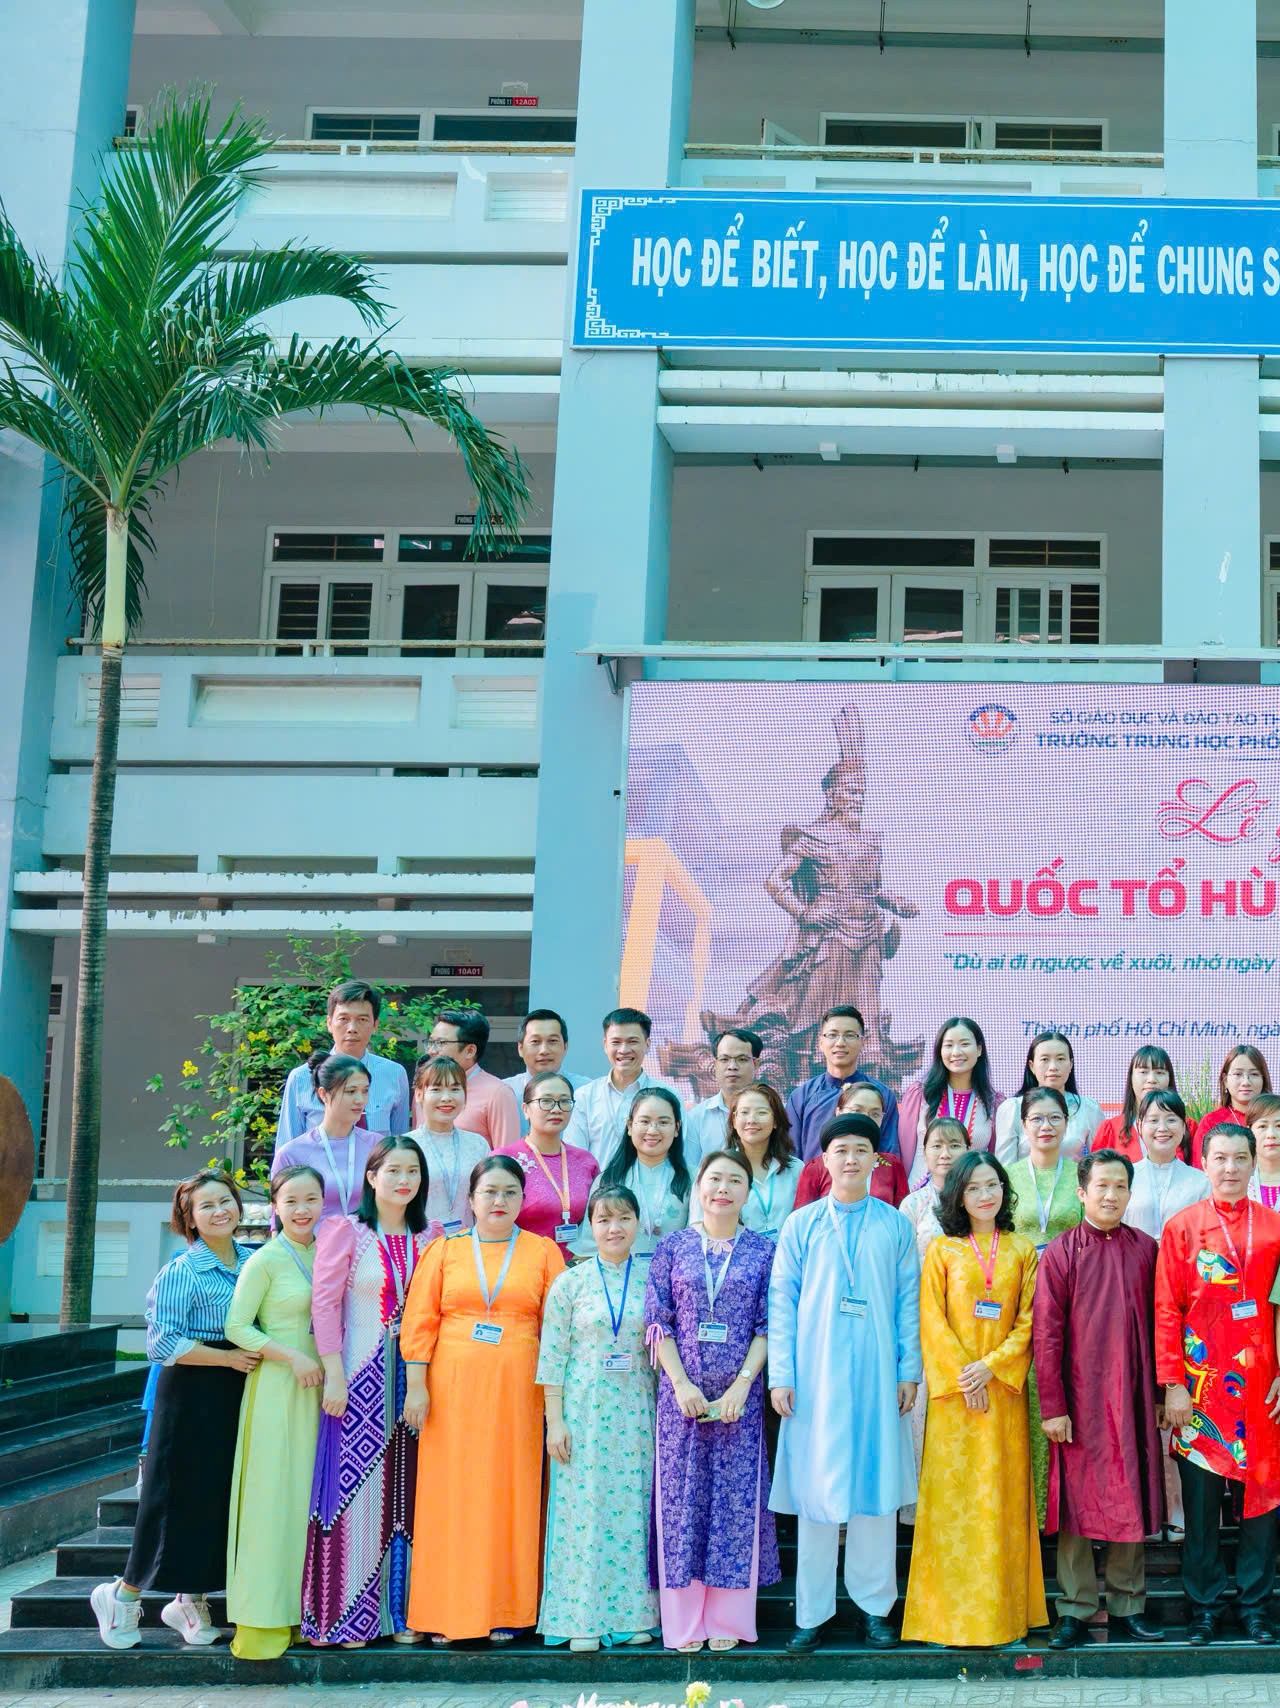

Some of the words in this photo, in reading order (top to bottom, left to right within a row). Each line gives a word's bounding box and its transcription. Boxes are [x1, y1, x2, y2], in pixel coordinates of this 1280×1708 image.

[515, 98, 537, 106] 12A03
[632, 237, 692, 297] HỌC
[701, 212, 745, 287] ĐỂ
[752, 221, 827, 299] BIẾT,
[838, 240, 897, 300] HỌC
[907, 215, 949, 290] ĐỂ
[958, 229, 1028, 302] LÀM,
[1039, 243, 1098, 303] HỌC
[1108, 219, 1149, 293] ĐỂ
[1157, 245, 1253, 296] CHUNG
[1050, 708, 1072, 724] SỞ
[1076, 709, 1116, 724] GIÁO
[1157, 709, 1179, 725] VÀ
[1036, 730, 1117, 748] TRƯỜNG
[1123, 734, 1190, 748] TRUNG
[1194, 734, 1235, 750] HỌC
[1157, 778, 1271, 843] Lễ
[944, 857, 1099, 917] QUỐC
[1110, 857, 1187, 917] TỔ
[986, 953, 1006, 970] ai
[1010, 953, 1028, 970] đi
[1032, 953, 1094, 973] ngược
[1100, 950, 1126, 970] về
[1129, 953, 1177, 973] xuôi,
[1182, 953, 1224, 970] nhớ
[1225, 953, 1276, 973] ngày
[1084, 1017, 1123, 1039] phố
[1126, 1018, 1153, 1036] Hồ
[1158, 1019, 1188, 1036] Chí
[1191, 1020, 1242, 1038] Minh,
